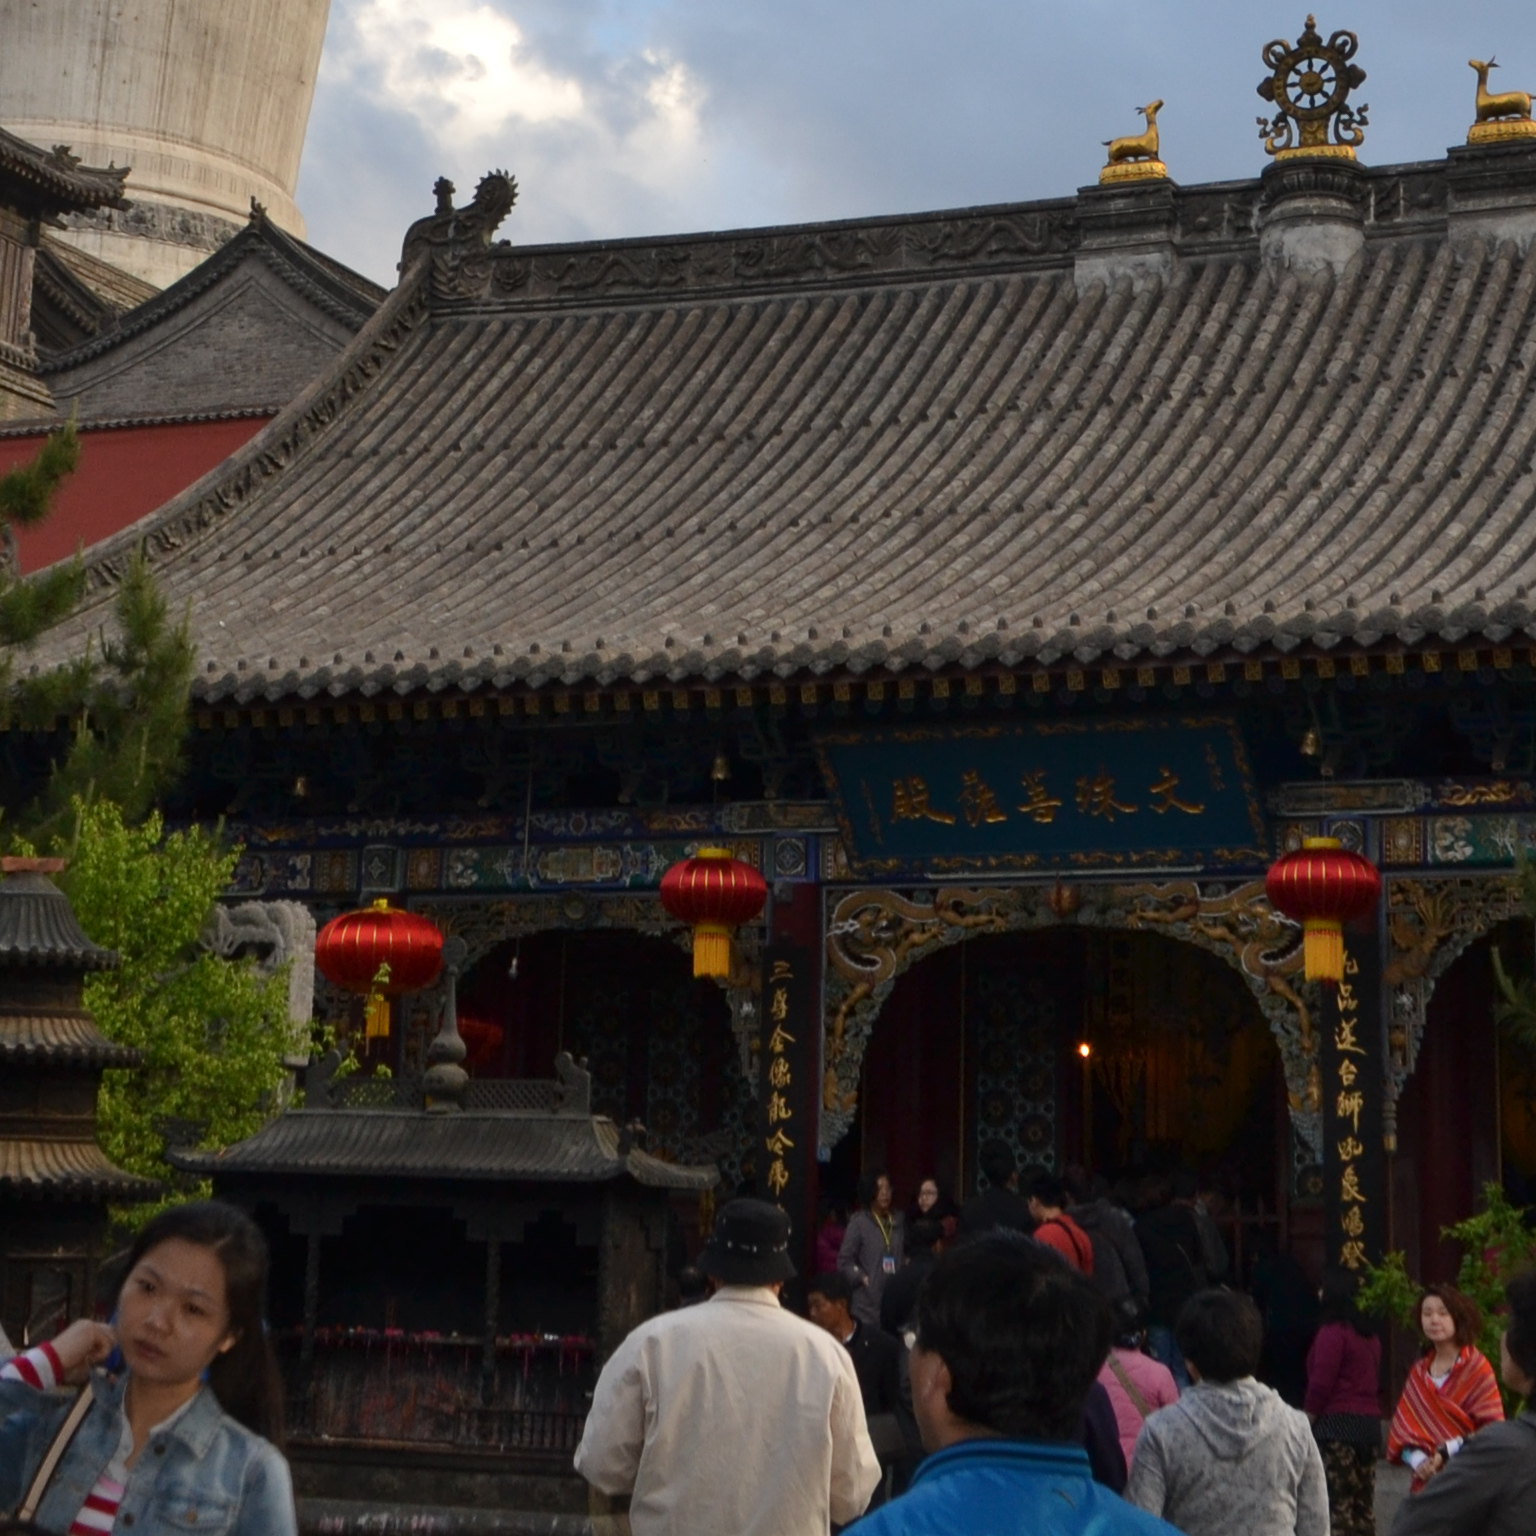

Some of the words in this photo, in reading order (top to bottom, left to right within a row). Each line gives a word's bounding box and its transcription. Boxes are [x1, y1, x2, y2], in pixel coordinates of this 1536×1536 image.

[765, 960, 796, 1212] 三尊金像龍吟虎
